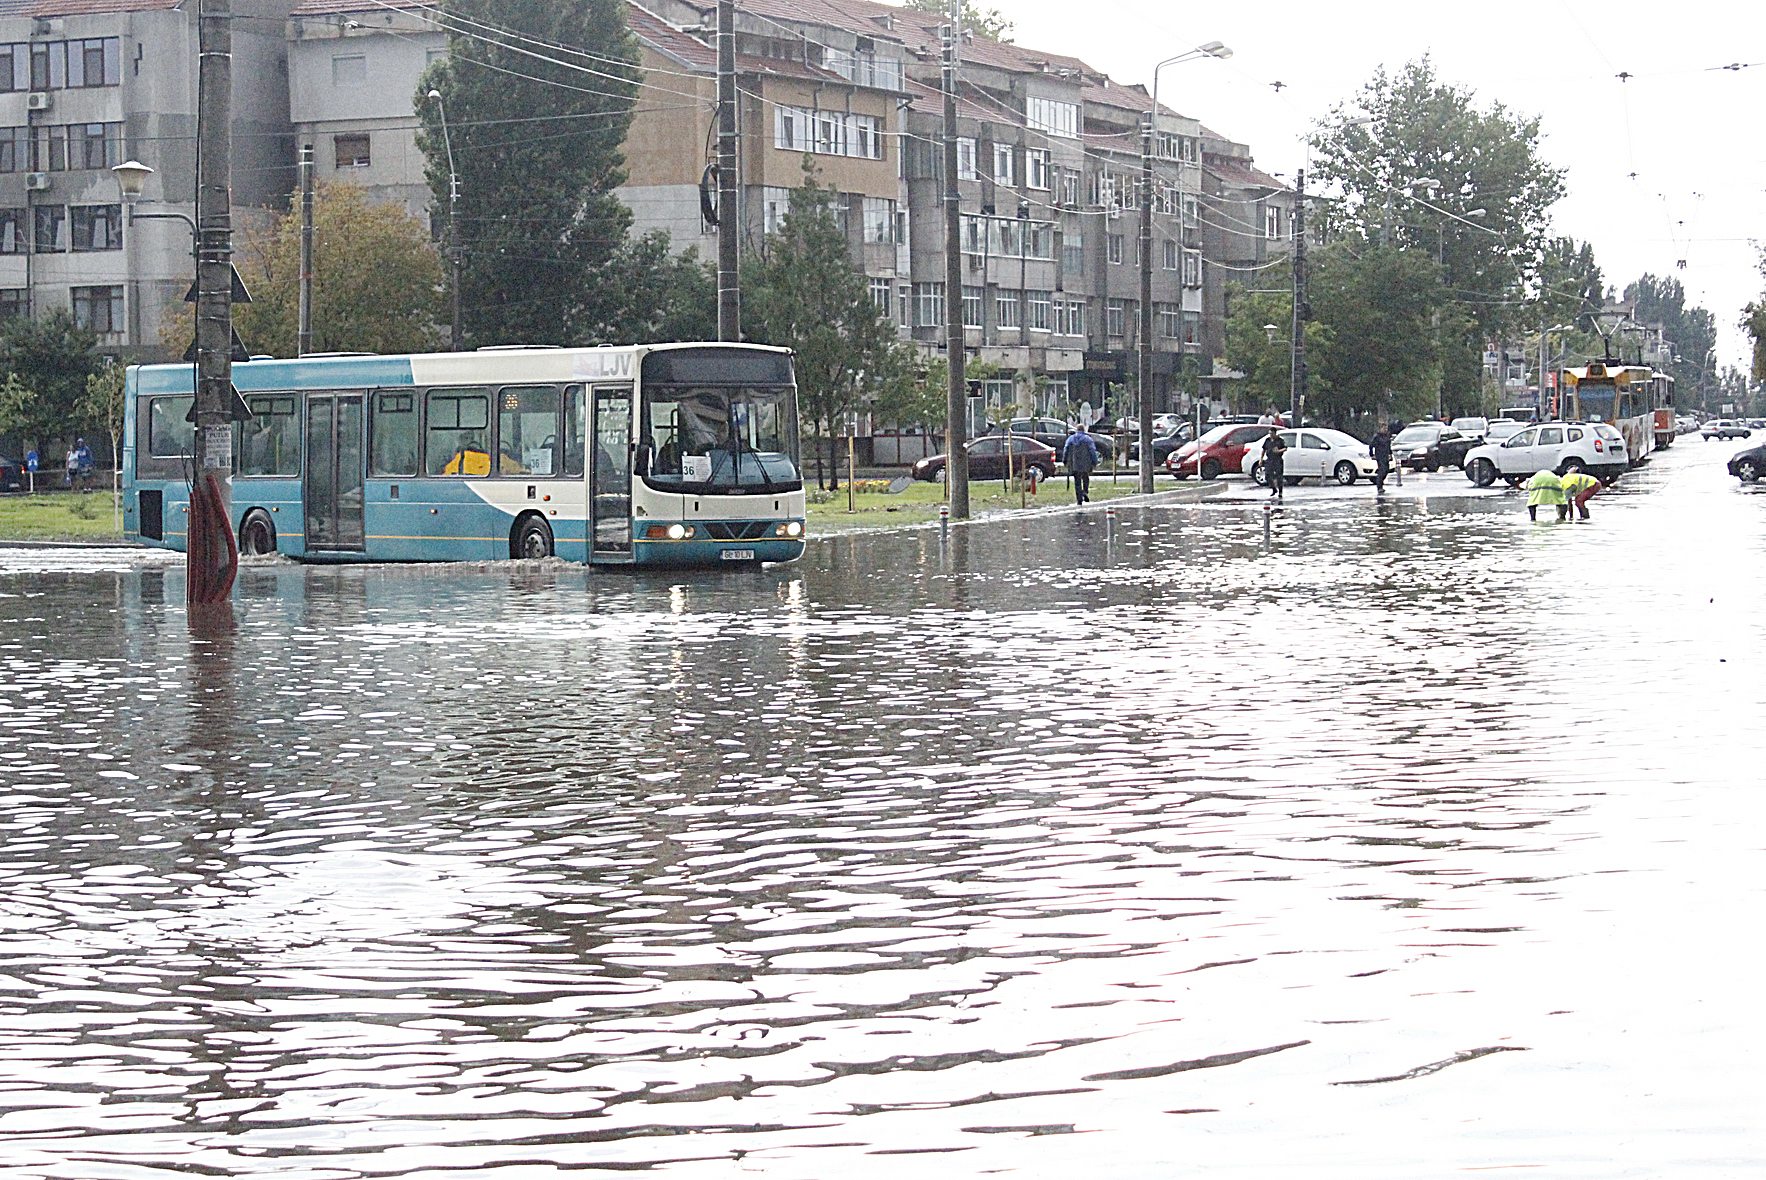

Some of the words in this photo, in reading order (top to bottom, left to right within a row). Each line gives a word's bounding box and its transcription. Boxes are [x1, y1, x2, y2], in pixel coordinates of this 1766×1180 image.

[601, 353, 632, 376] LJV
[530, 458, 540, 469] 36
[683, 465, 695, 476] 36
